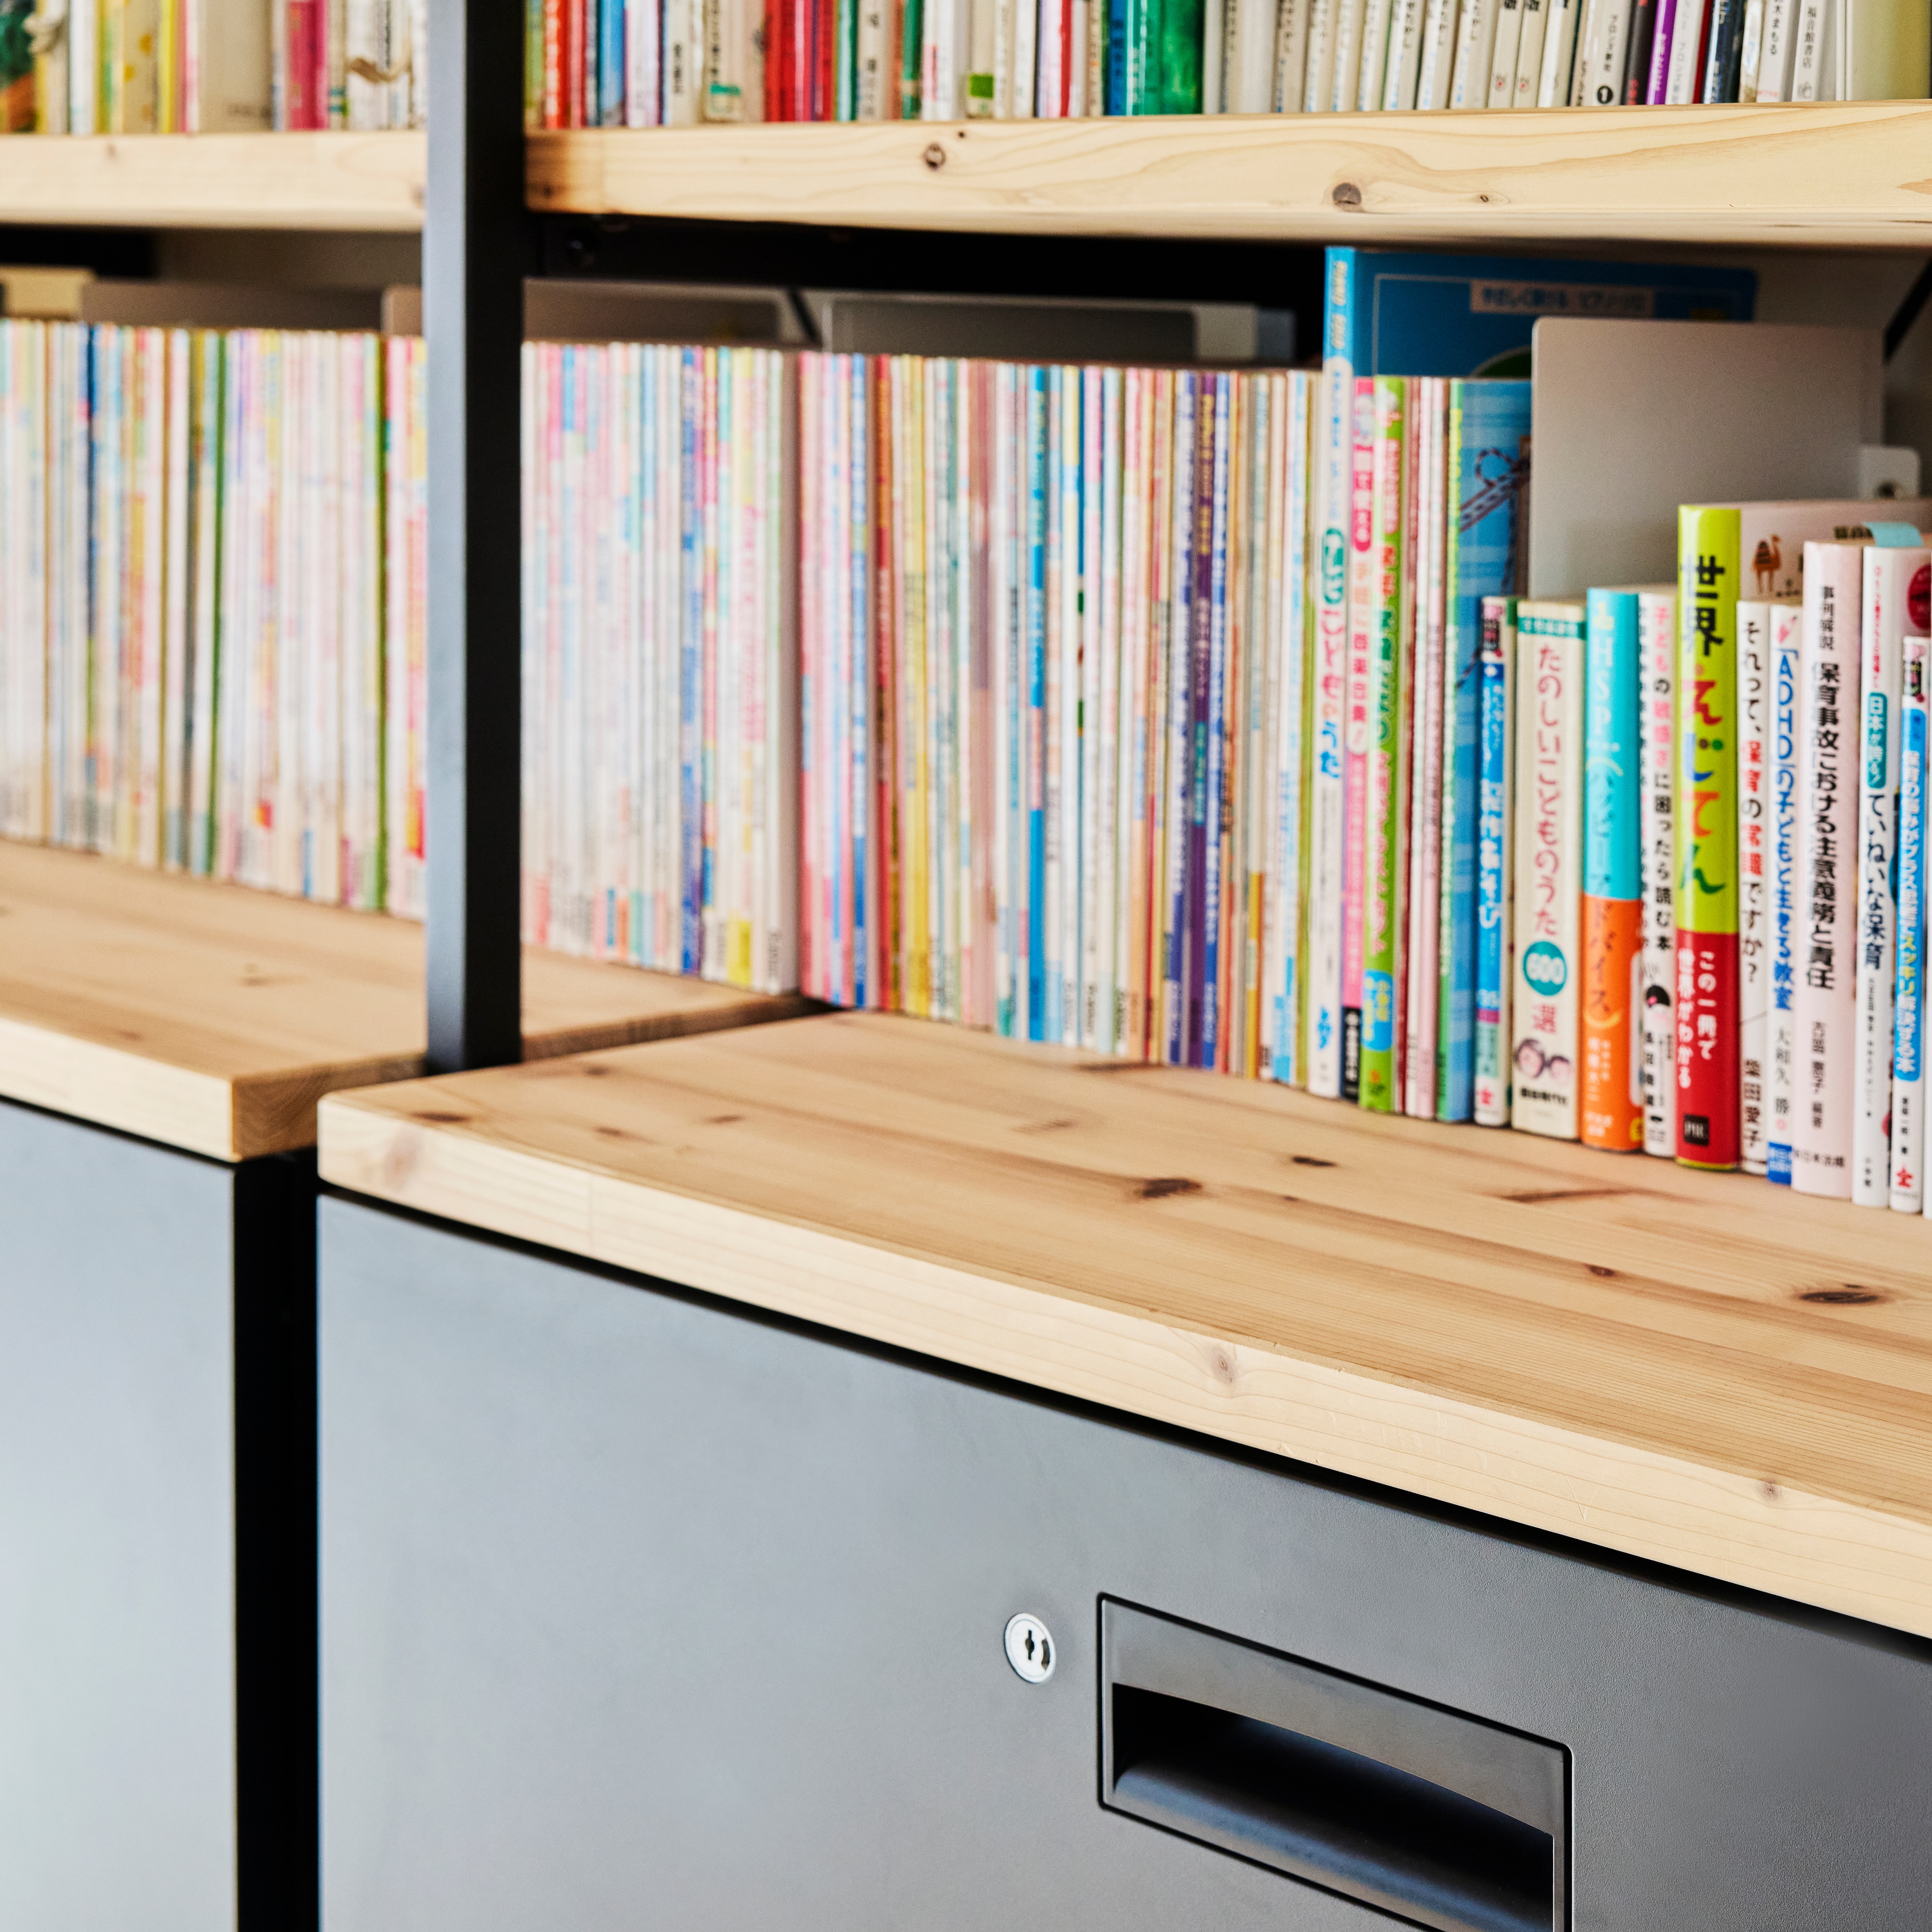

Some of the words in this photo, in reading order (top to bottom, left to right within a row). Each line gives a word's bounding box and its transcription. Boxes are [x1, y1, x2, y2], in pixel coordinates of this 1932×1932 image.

[1769, 0, 1784, 56] 木まもる
[1803, 5, 1817, 69] 福音館書店
[1534, 643, 1562, 935] たのしいこどものうた
[1679, 554, 1726, 894] 世界えじてん
[1864, 794, 1888, 970] ていねいな保育
[1677, 948, 1695, 1088] 世界がわかる
[1697, 951, 1717, 1060] この一冊で
